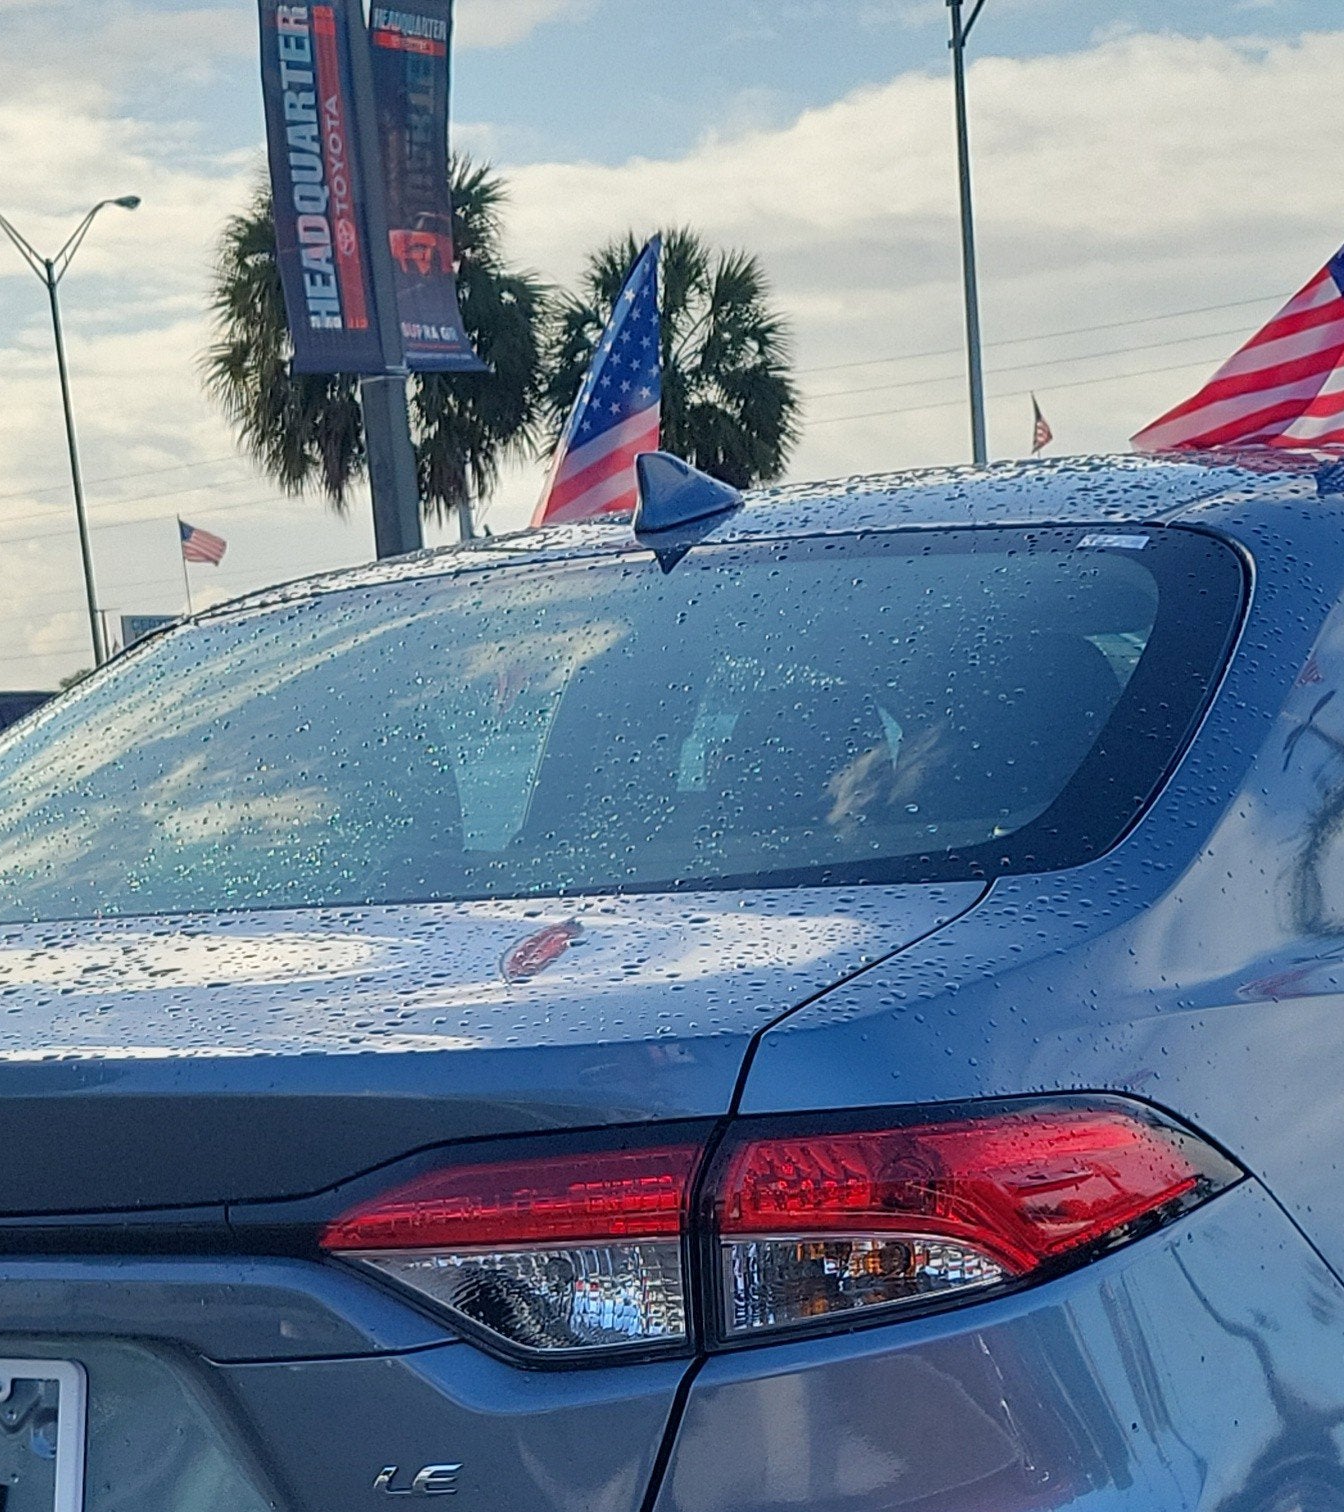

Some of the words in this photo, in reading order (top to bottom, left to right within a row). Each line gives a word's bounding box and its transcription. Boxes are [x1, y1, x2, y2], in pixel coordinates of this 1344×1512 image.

[277, 5, 342, 329] HEADQUARTER
[324, 94, 350, 214] TOYOTA
[373, 1463, 464, 1495] LE
